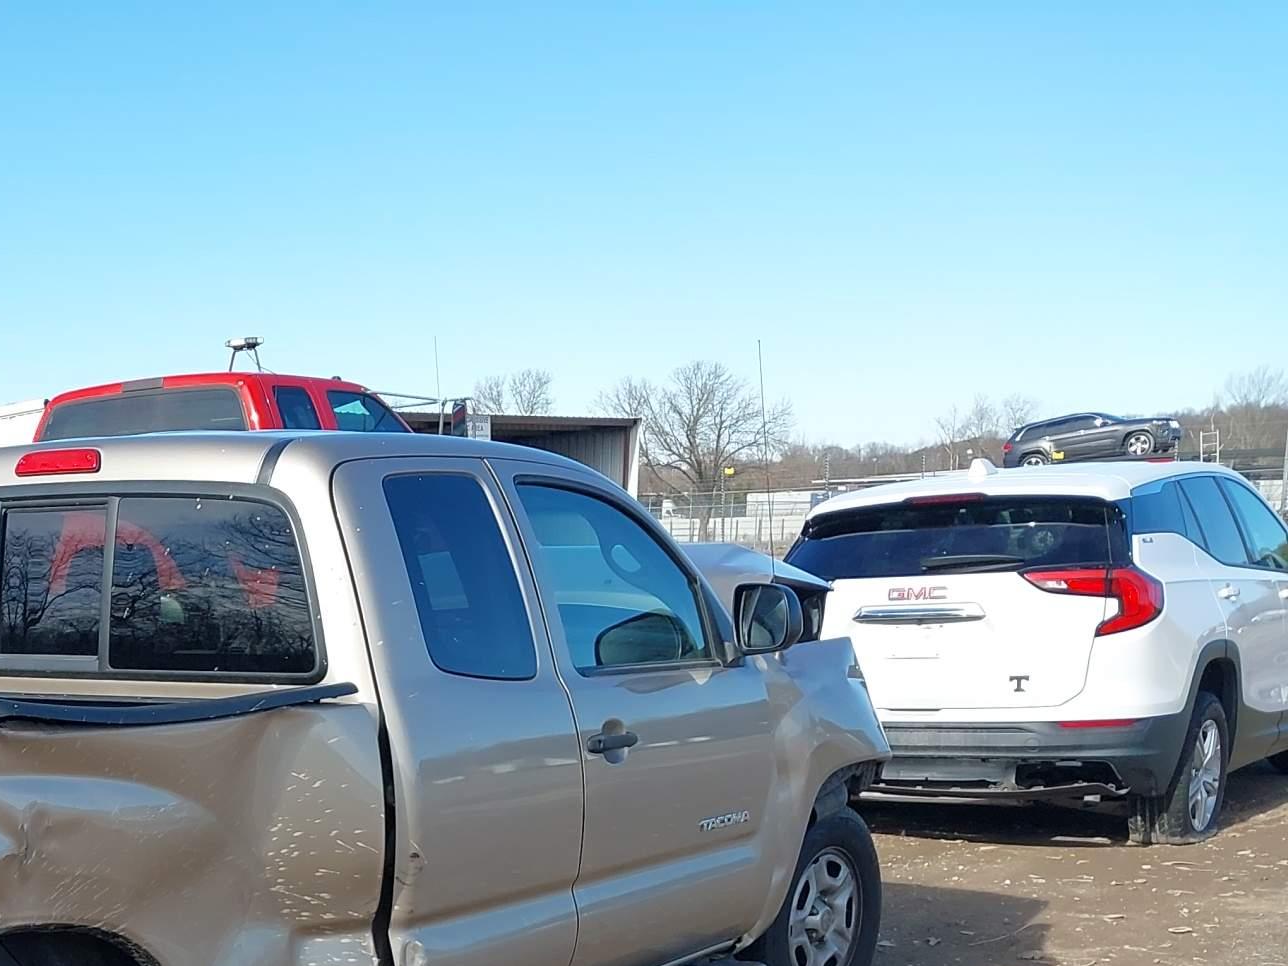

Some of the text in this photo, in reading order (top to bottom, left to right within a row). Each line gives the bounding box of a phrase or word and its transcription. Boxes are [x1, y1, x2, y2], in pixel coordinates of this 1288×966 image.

[888, 586, 948, 601] GMC
[1009, 675, 1030, 692] T
[698, 810, 750, 832] TACOMA
